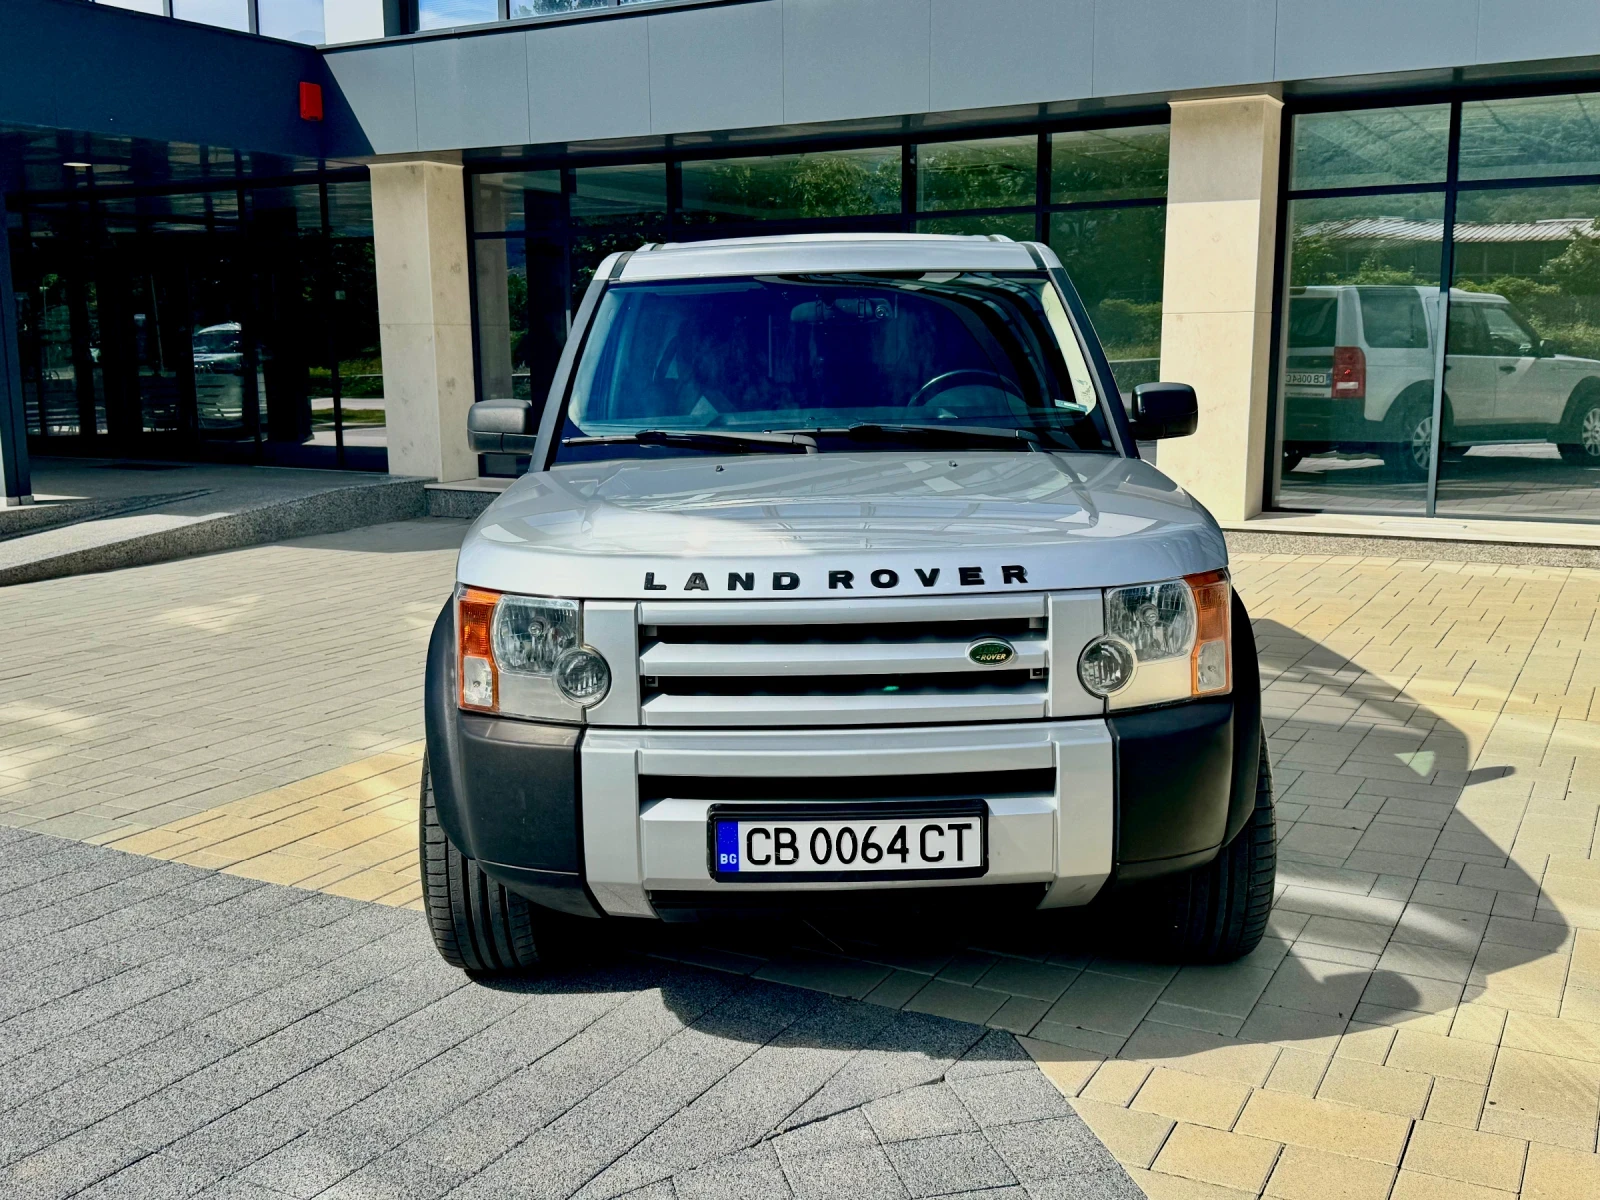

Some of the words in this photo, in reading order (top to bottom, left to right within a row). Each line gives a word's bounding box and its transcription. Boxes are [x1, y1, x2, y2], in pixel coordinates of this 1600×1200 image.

[643, 571, 801, 592] LAND
[827, 565, 1029, 591] ROVER
[746, 827, 800, 866] CB
[809, 825, 909, 866] 0064
[919, 823, 972, 863] CT
[720, 853, 738, 865] BG
